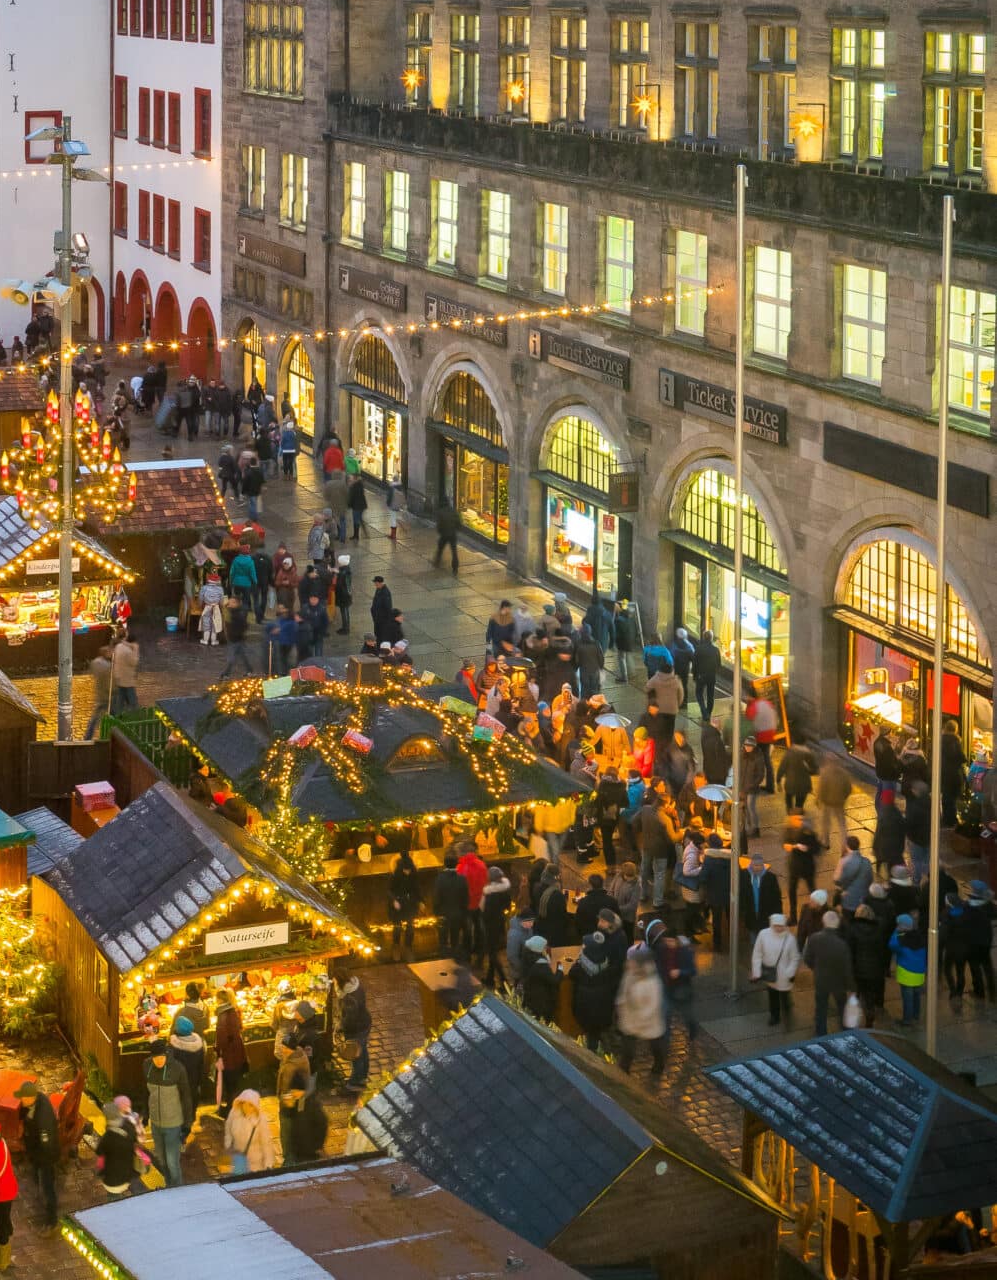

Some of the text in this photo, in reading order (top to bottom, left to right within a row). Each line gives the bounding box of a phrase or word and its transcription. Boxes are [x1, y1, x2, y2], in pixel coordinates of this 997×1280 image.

[547, 335, 584, 364] Tourist
[585, 348, 624, 377] Service
[687, 381, 728, 413] Ticket
[729, 394, 779, 430] Srvice
[222, 928, 276, 945] Naturseife
